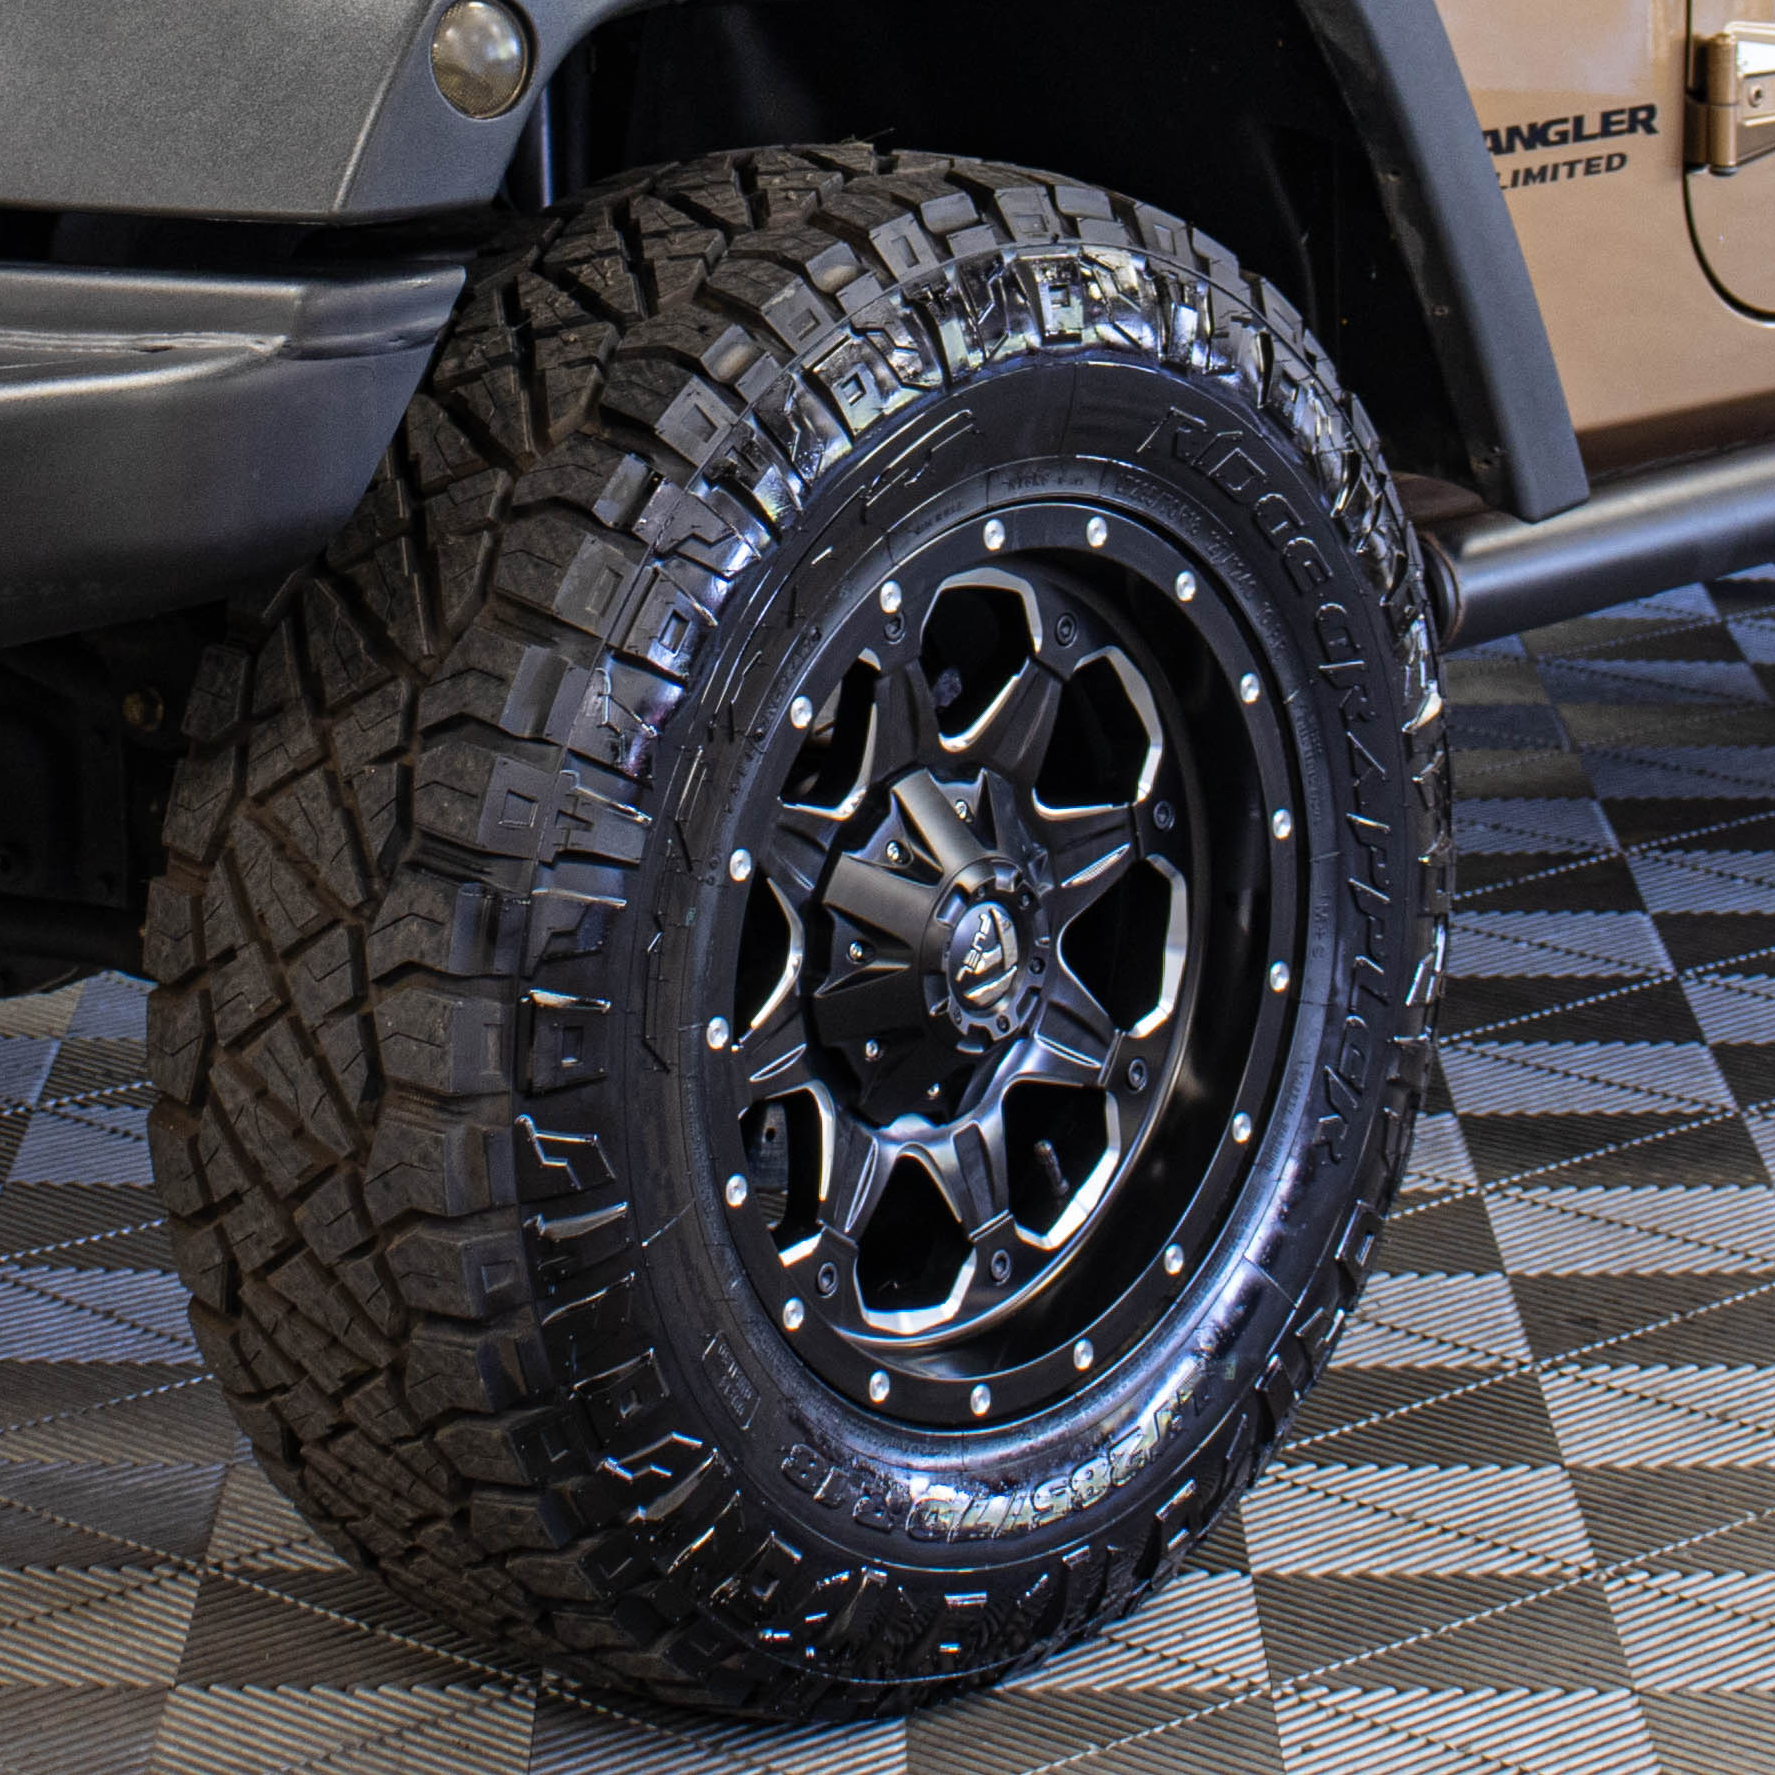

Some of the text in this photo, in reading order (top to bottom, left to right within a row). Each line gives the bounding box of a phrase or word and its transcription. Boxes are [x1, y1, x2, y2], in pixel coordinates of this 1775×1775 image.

[1482, 103, 1658, 156] ANGLER
[1496, 151, 1628, 191] LIMITED
[954, 912, 993, 983] FUEL
